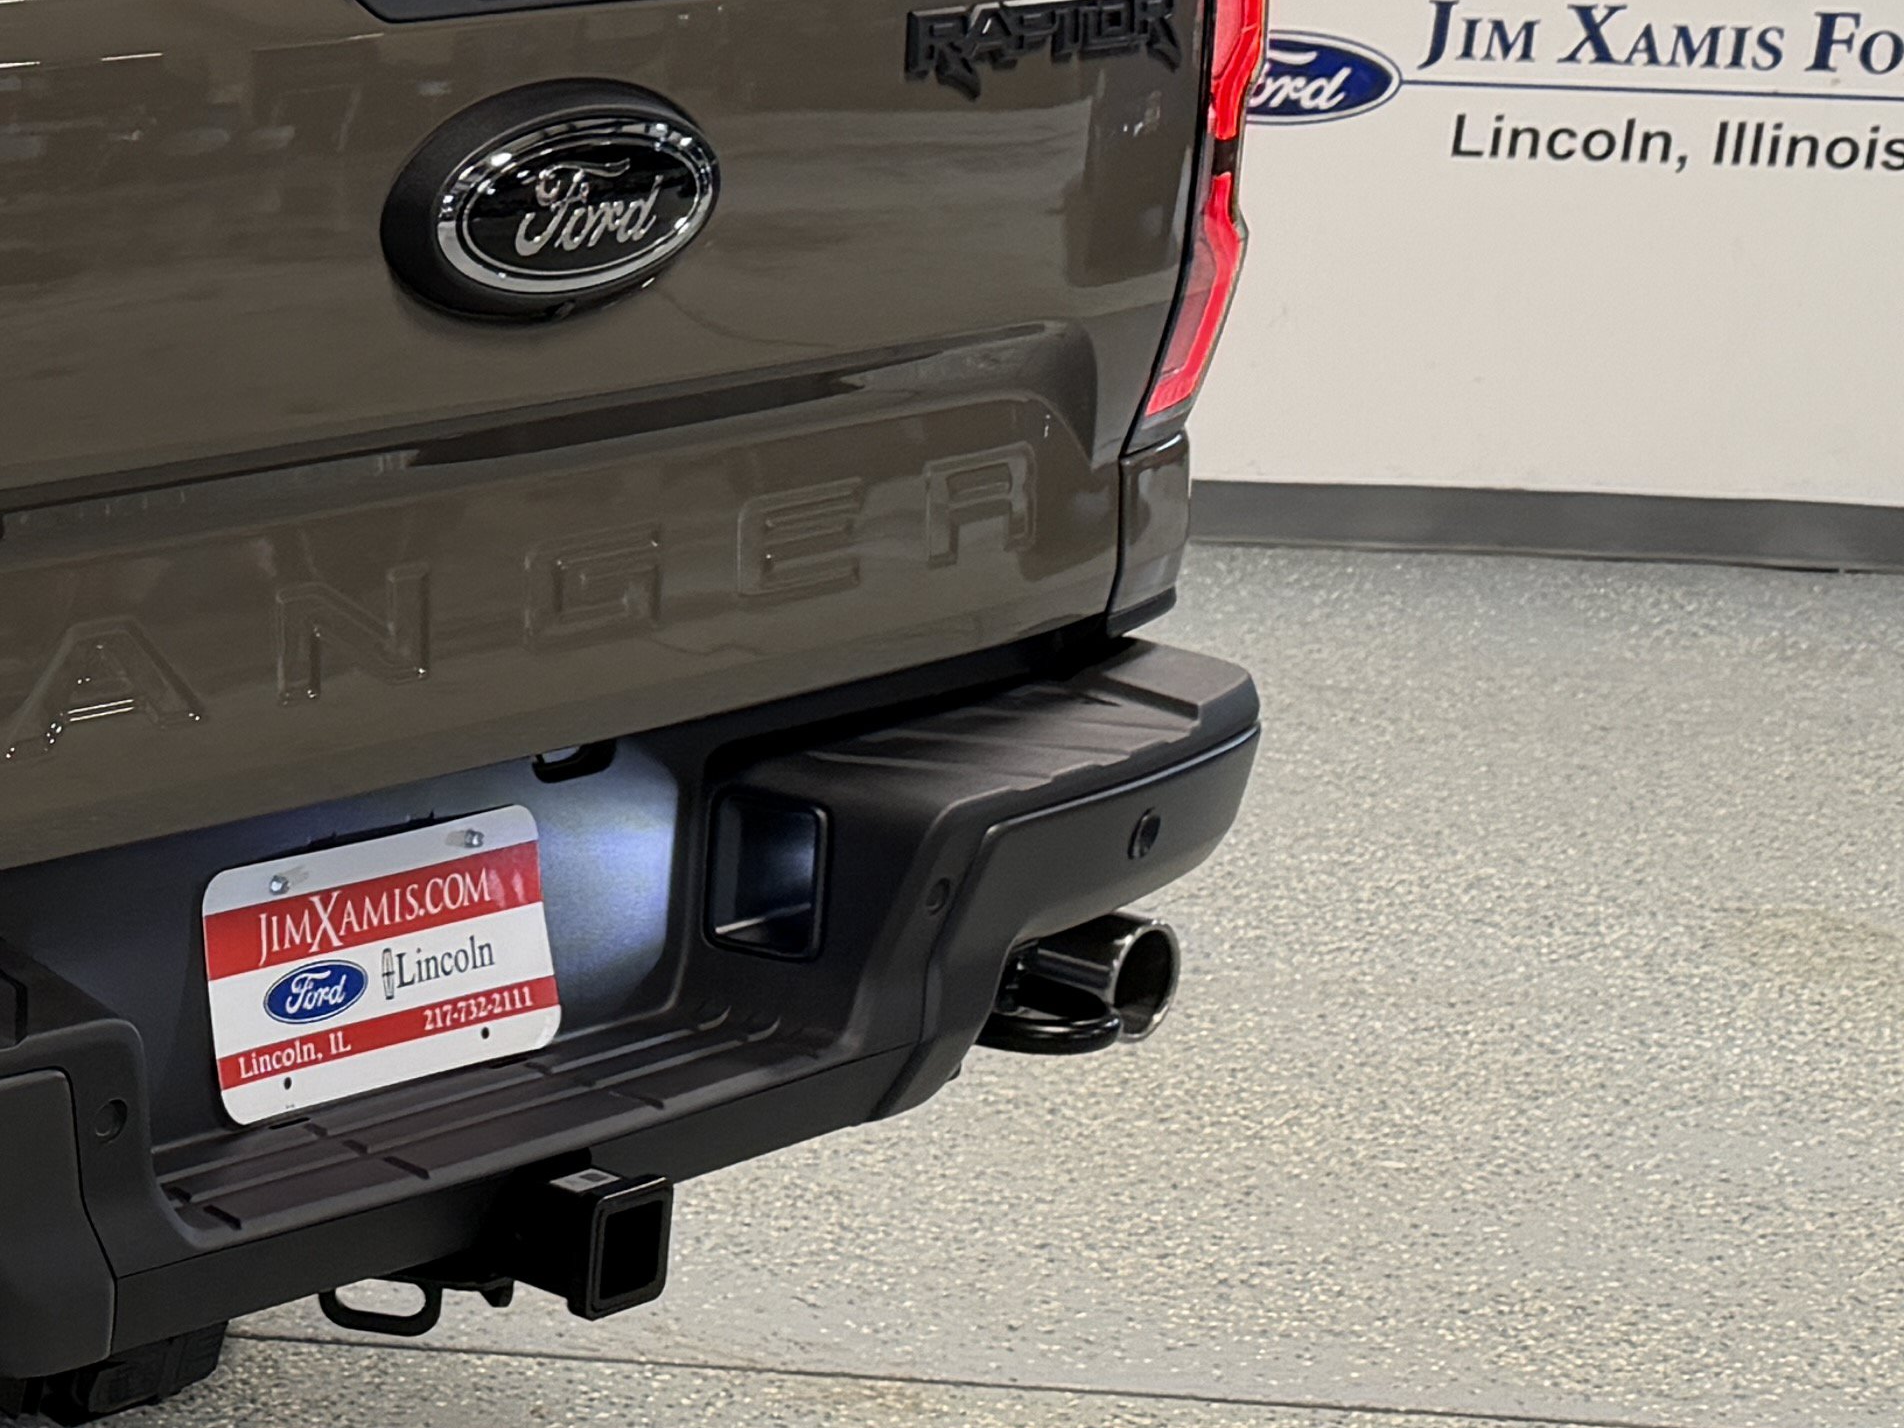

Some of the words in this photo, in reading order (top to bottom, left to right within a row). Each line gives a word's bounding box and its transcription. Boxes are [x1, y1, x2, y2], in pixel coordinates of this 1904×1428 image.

[1417, 0, 1541, 70] JIM
[1557, 4, 1785, 71] XAMIS
[1804, 11, 1904, 76] FO
[1451, 113, 1689, 173] Lincoln,
[514, 156, 664, 257] Ford
[258, 868, 492, 966] JIMXAMIS.COM
[396, 935, 495, 988] Lincoln
[423, 987, 533, 1031] 217-732-2111
[238, 1038, 324, 1079] Lincoln,
[330, 1031, 352, 1055] IL
